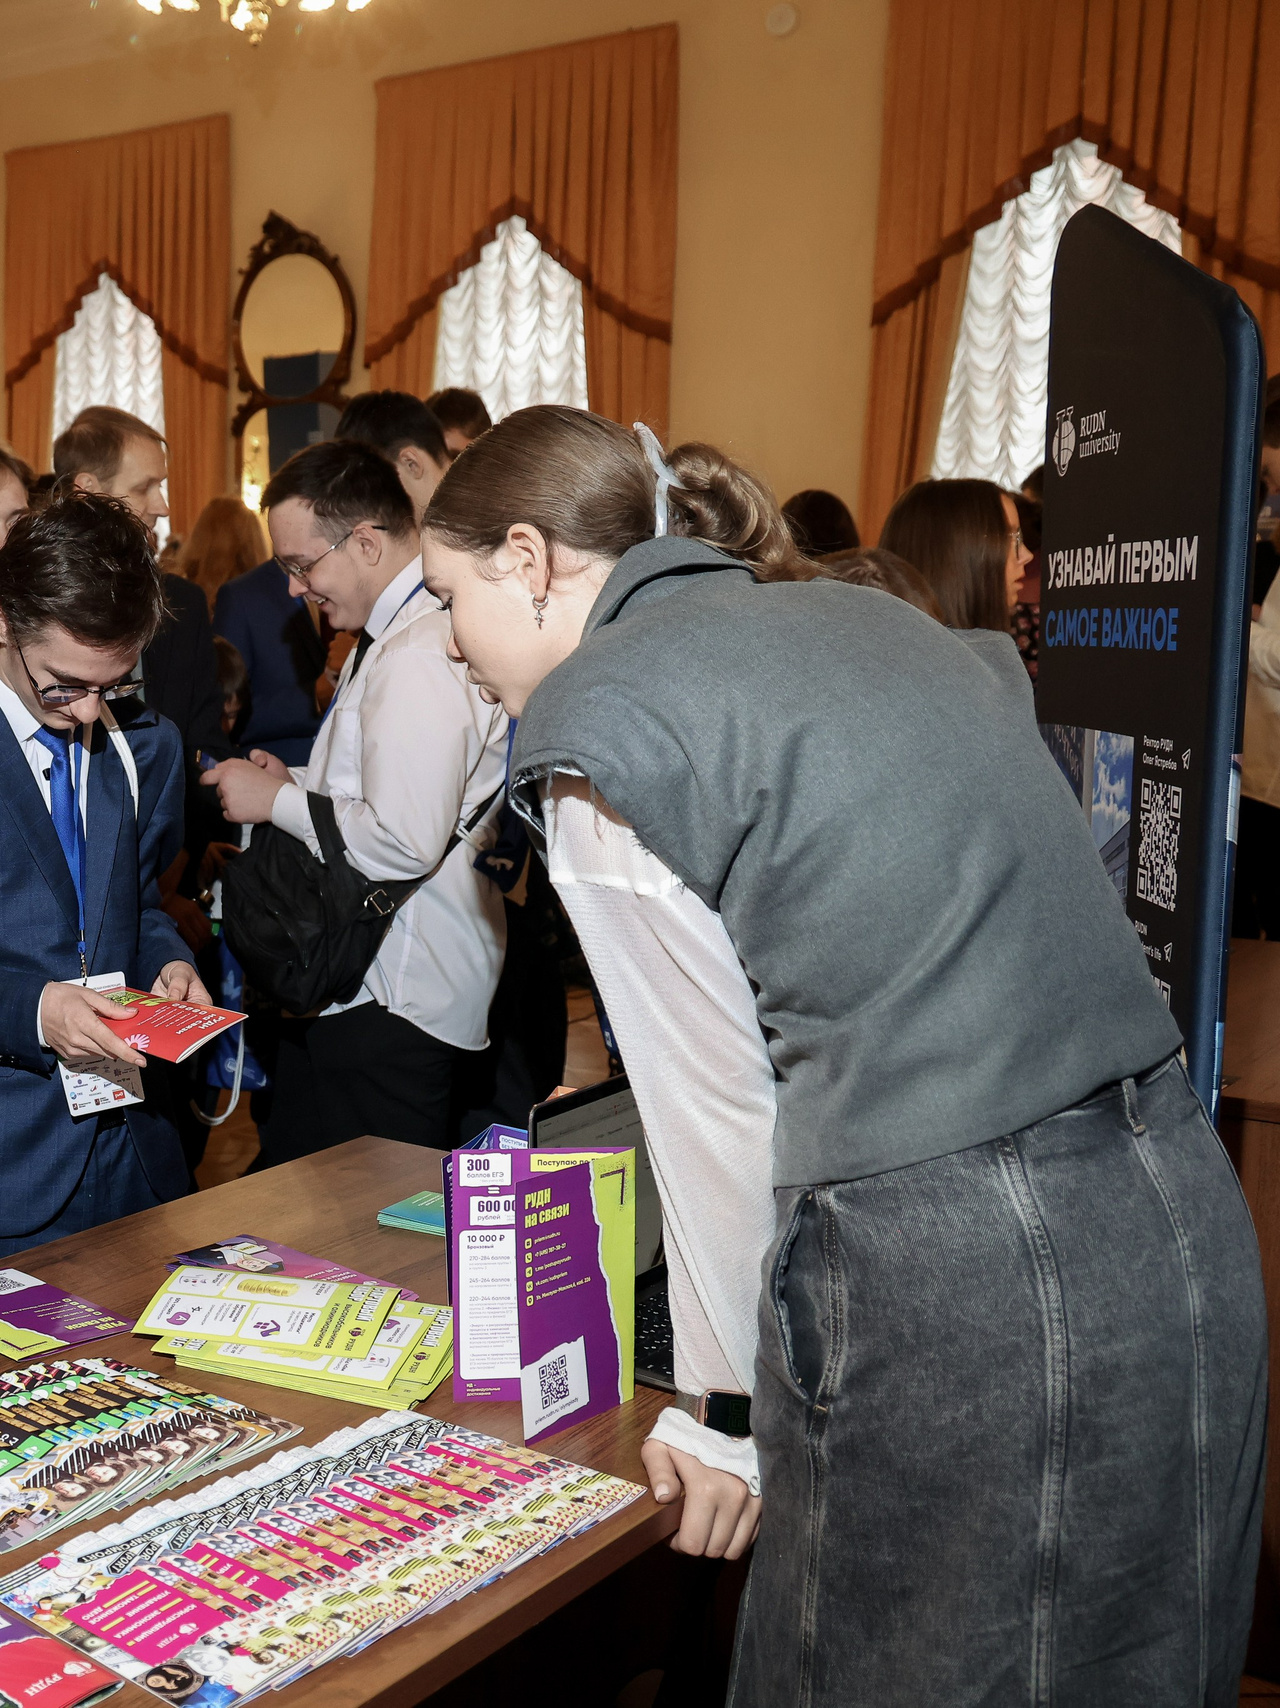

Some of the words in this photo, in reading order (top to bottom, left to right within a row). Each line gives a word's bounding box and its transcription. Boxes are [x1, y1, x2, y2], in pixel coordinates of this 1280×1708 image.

[1080, 410, 1107, 437] RUDN
[1079, 429, 1122, 458] university
[1048, 534, 1116, 590] УЗНАВАЙ
[1119, 535, 1199, 584] ПЕРВЫМ
[1045, 608, 1098, 648] САМОЕ
[1102, 607, 1180, 652] ВАЖНОЕ
[1160, 738, 1174, 752] РУДН
[467, 1158, 490, 1171] 300
[537, 1159, 577, 1167] Поступаю
[478, 1200, 501, 1212] 600
[524, 1188, 552, 1210] РУДН
[524, 1214, 538, 1229] на
[538, 1202, 570, 1225] связи
[479, 1234, 497, 1242] 000
[172, 1525, 193, 1545] XPORT
[111, 1550, 135, 1571] XPORT
[81, 1605, 104, 1621] ДЕЛО
[88, 1594, 140, 1626] ТАМОЖЕННОЕ
[125, 1589, 171, 1618] УПРАВЛЕНИЕ
[113, 1609, 162, 1639] ЭКОНОМИКА
[133, 1603, 198, 1643] ЮРИСПРУДЕНЦИЯ
[155, 1633, 180, 1649] РУДН
[23, 1673, 64, 1698] РУДН
